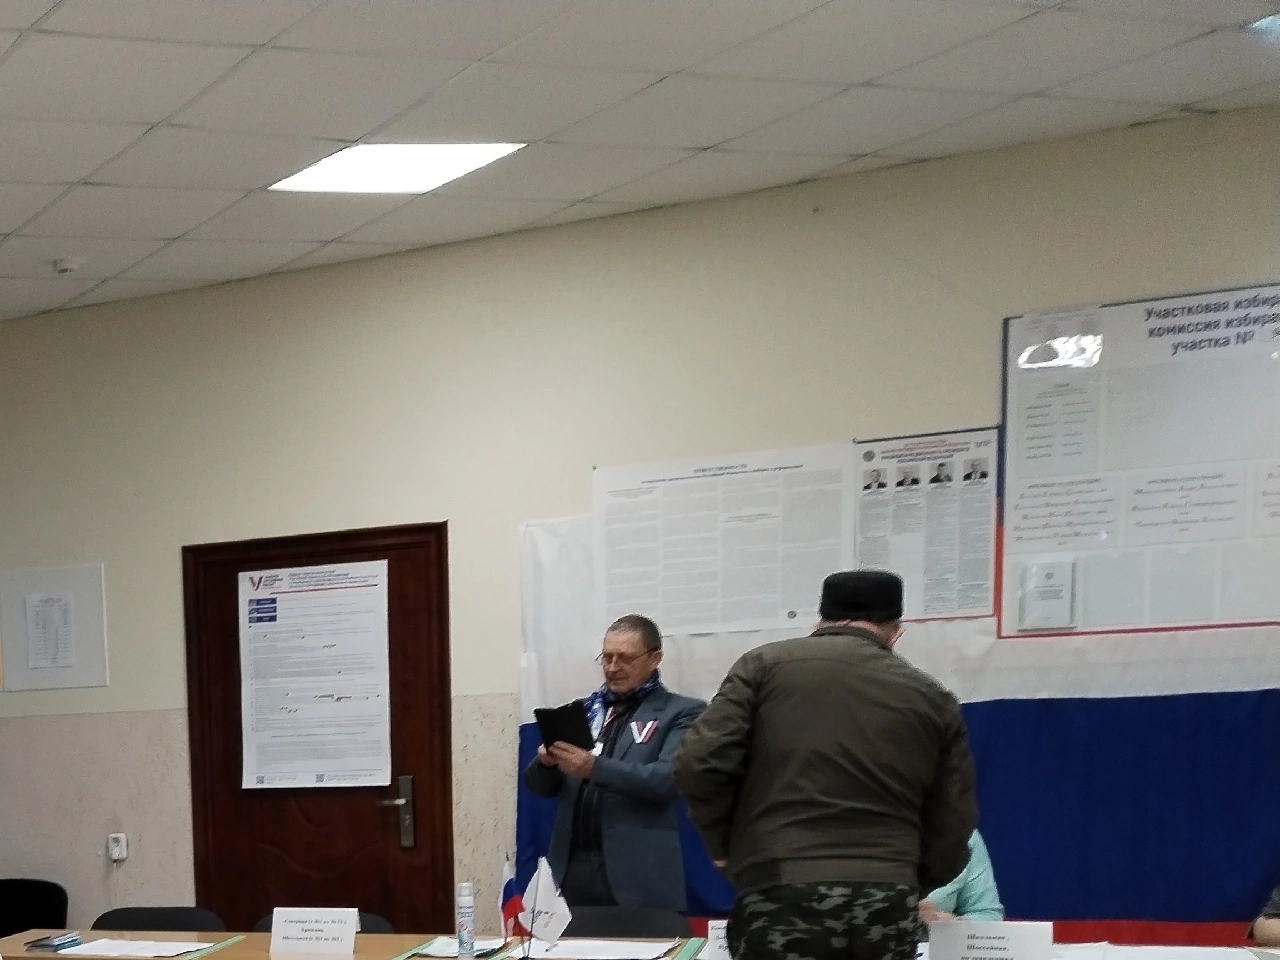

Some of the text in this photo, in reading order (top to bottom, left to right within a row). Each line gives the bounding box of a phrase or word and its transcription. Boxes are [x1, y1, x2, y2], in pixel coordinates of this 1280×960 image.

[1143, 301, 1230, 322] Участковая
[1148, 319, 1222, 338] комиссия
[1171, 336, 1231, 356] участка
